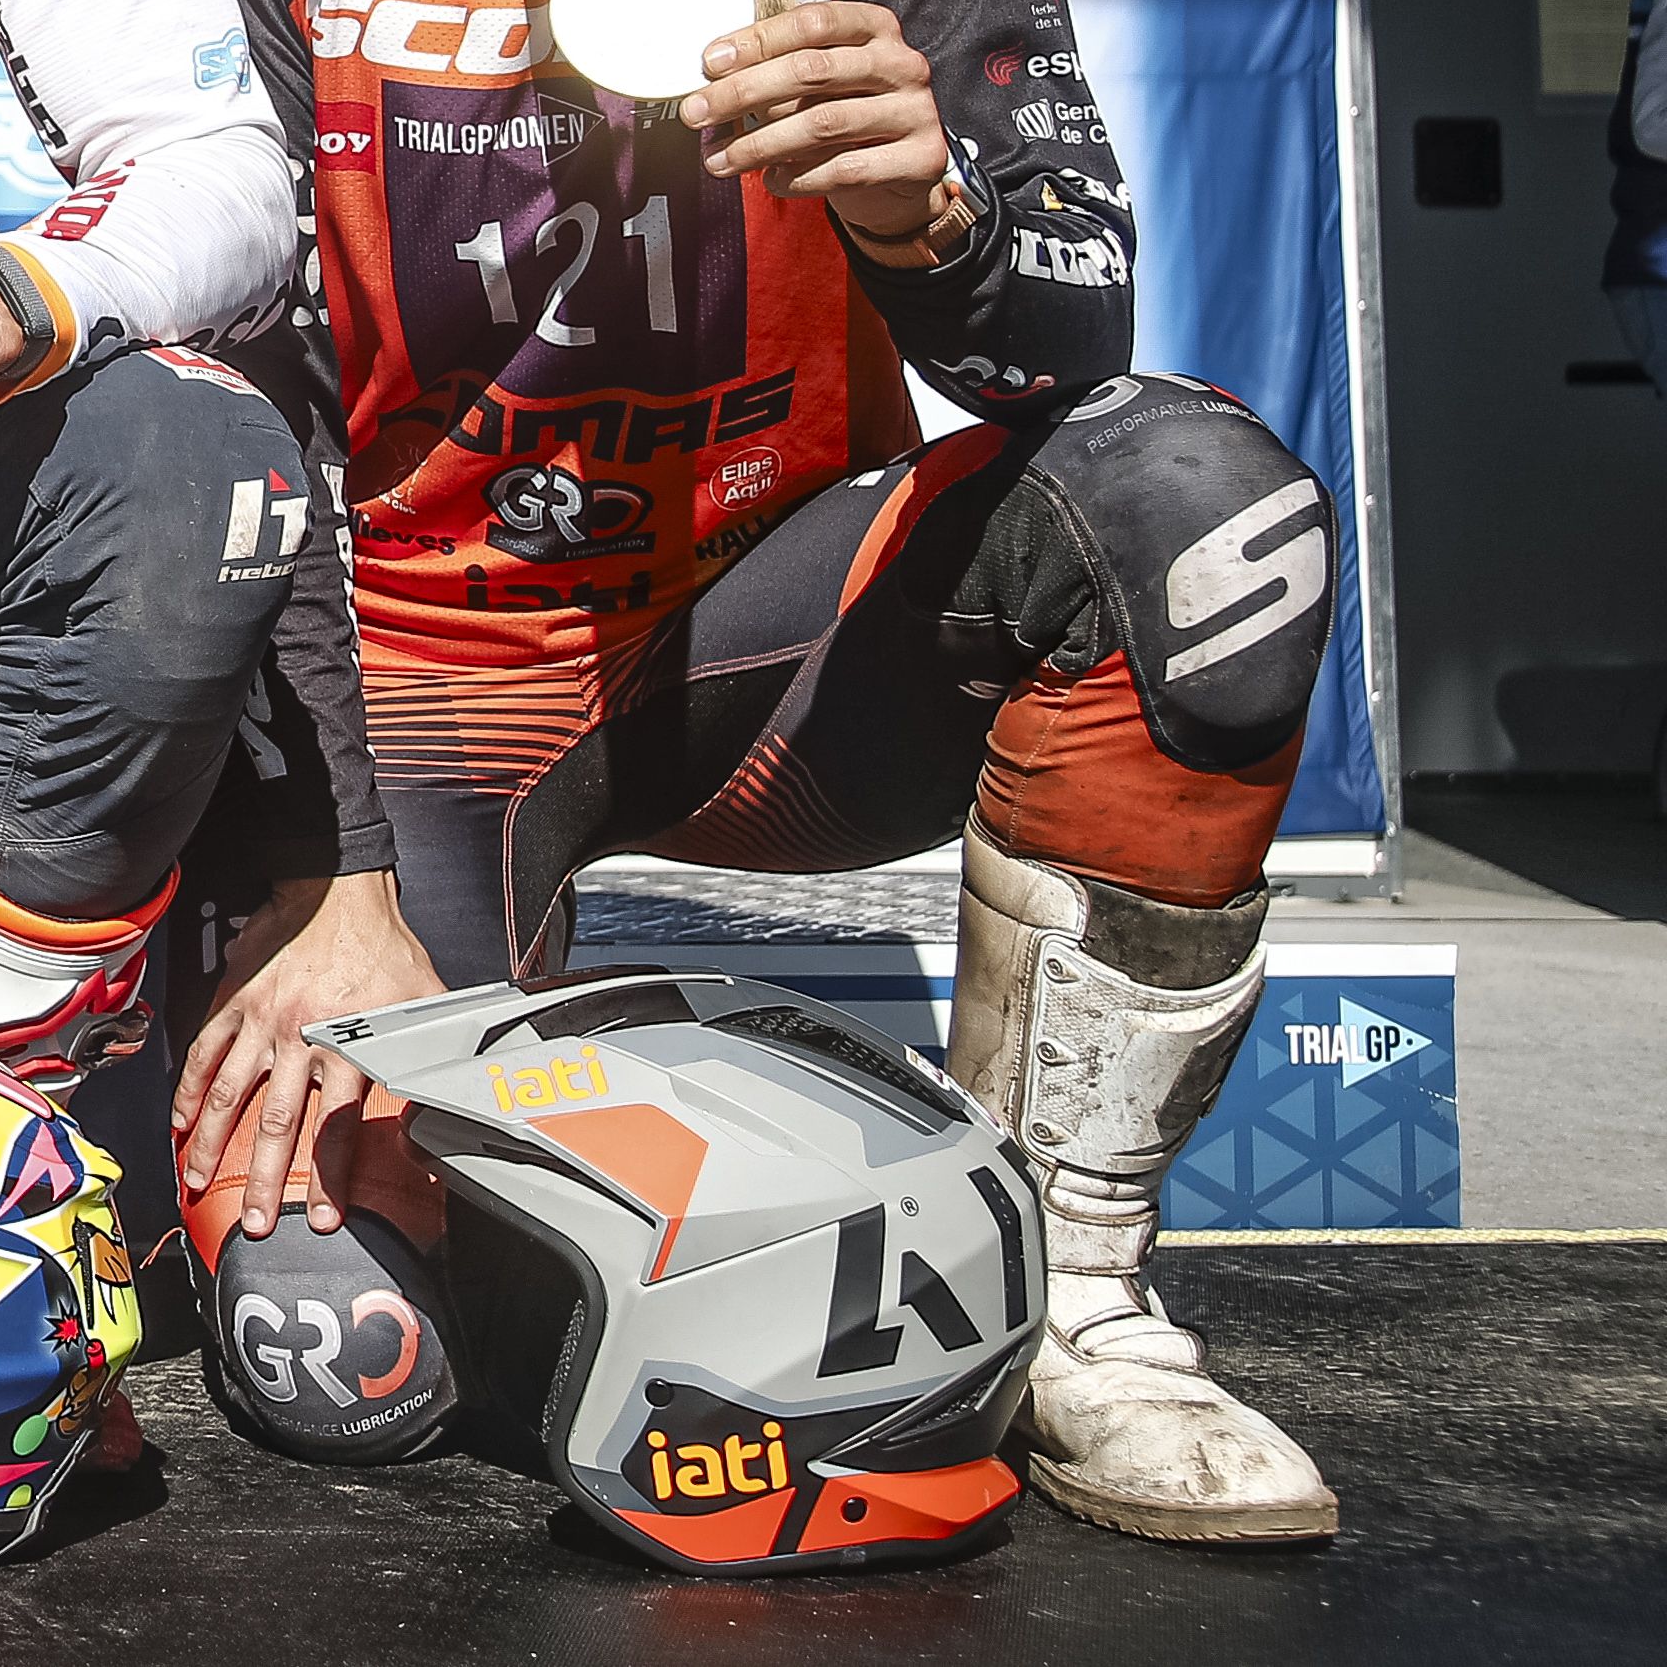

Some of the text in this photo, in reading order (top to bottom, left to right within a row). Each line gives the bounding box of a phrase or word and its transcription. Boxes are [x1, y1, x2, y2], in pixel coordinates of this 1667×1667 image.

[454, 194, 677, 347] 121
[1086, 399, 1203, 455] PERFORMANCE
[721, 456, 773, 483] Ellas
[1283, 1023, 1402, 1065] TRIALGP
[485, 1044, 610, 1116] iati
[341, 1387, 435, 1436] LUBRICATION
[647, 1419, 788, 1503] iati
